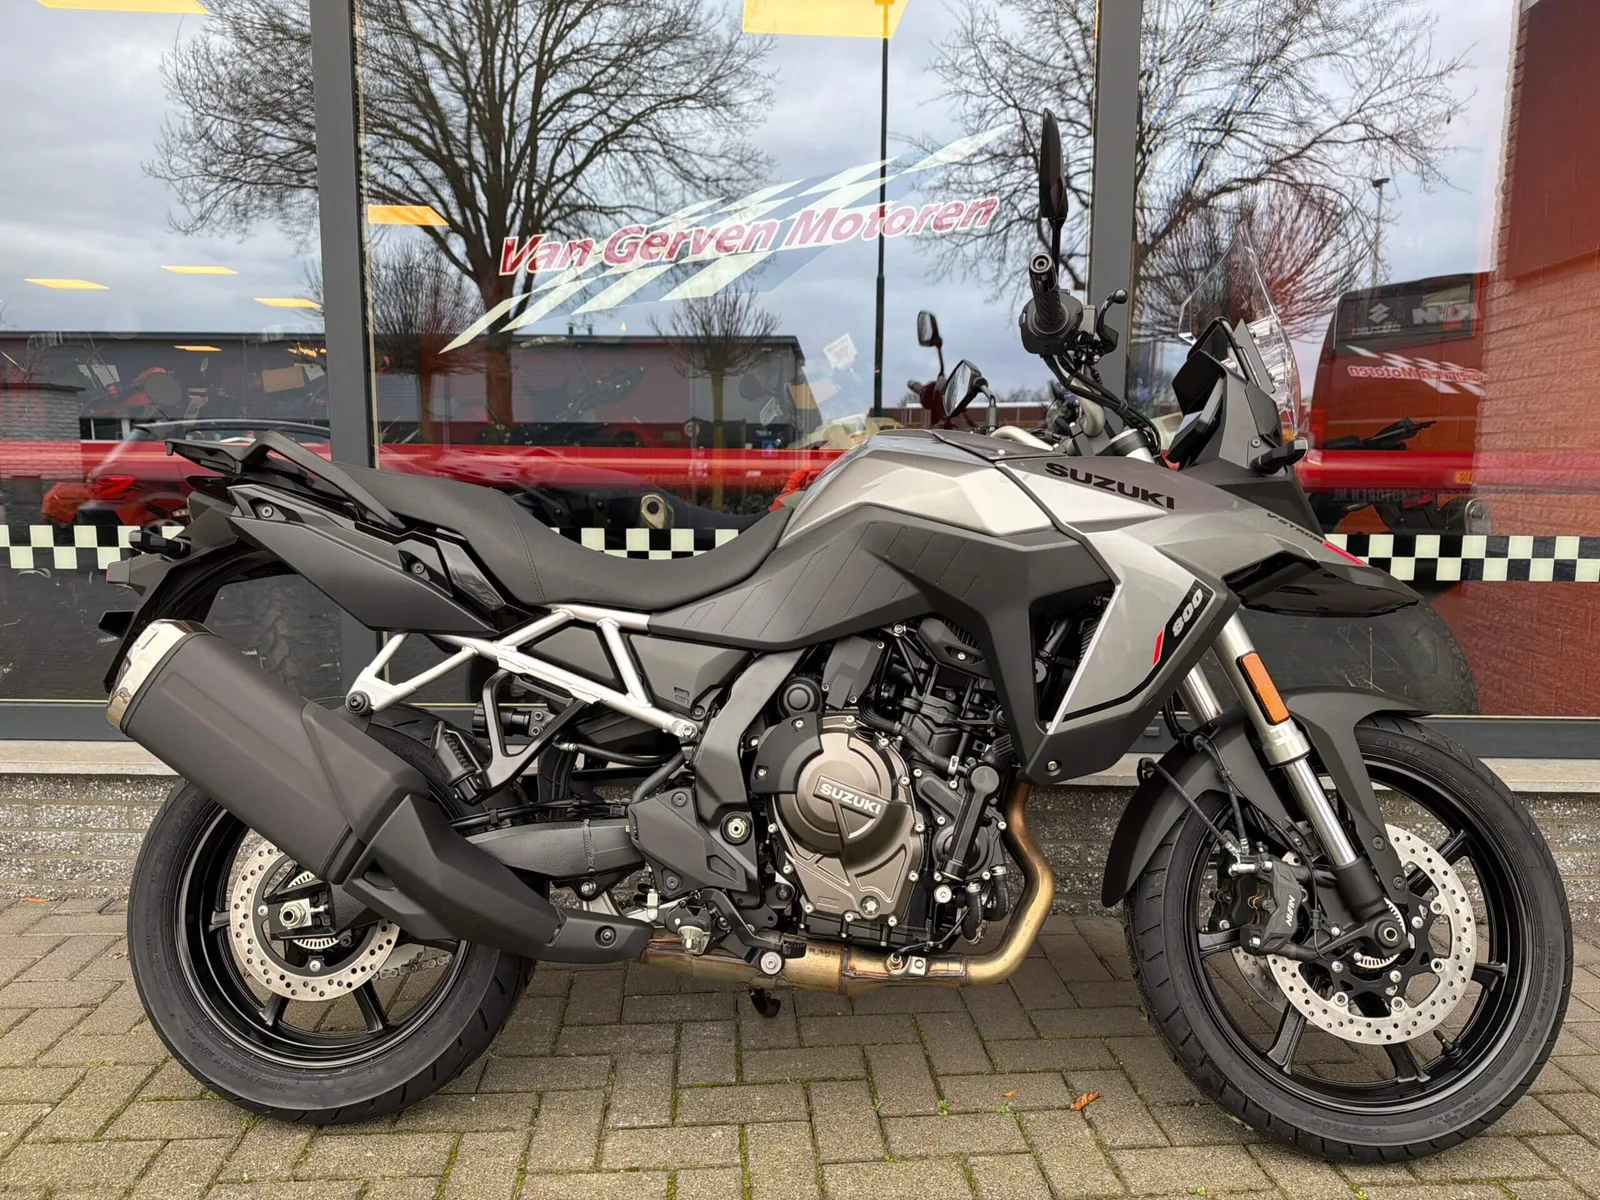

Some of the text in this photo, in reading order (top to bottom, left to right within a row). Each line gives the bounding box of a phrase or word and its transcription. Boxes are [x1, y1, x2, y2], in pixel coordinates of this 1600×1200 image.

[499, 196, 1000, 276] Van Gerven Motoren
[1045, 462, 1175, 510] SUZUKI
[1172, 588, 1203, 637] 800
[820, 783, 881, 815] SUZUKI
